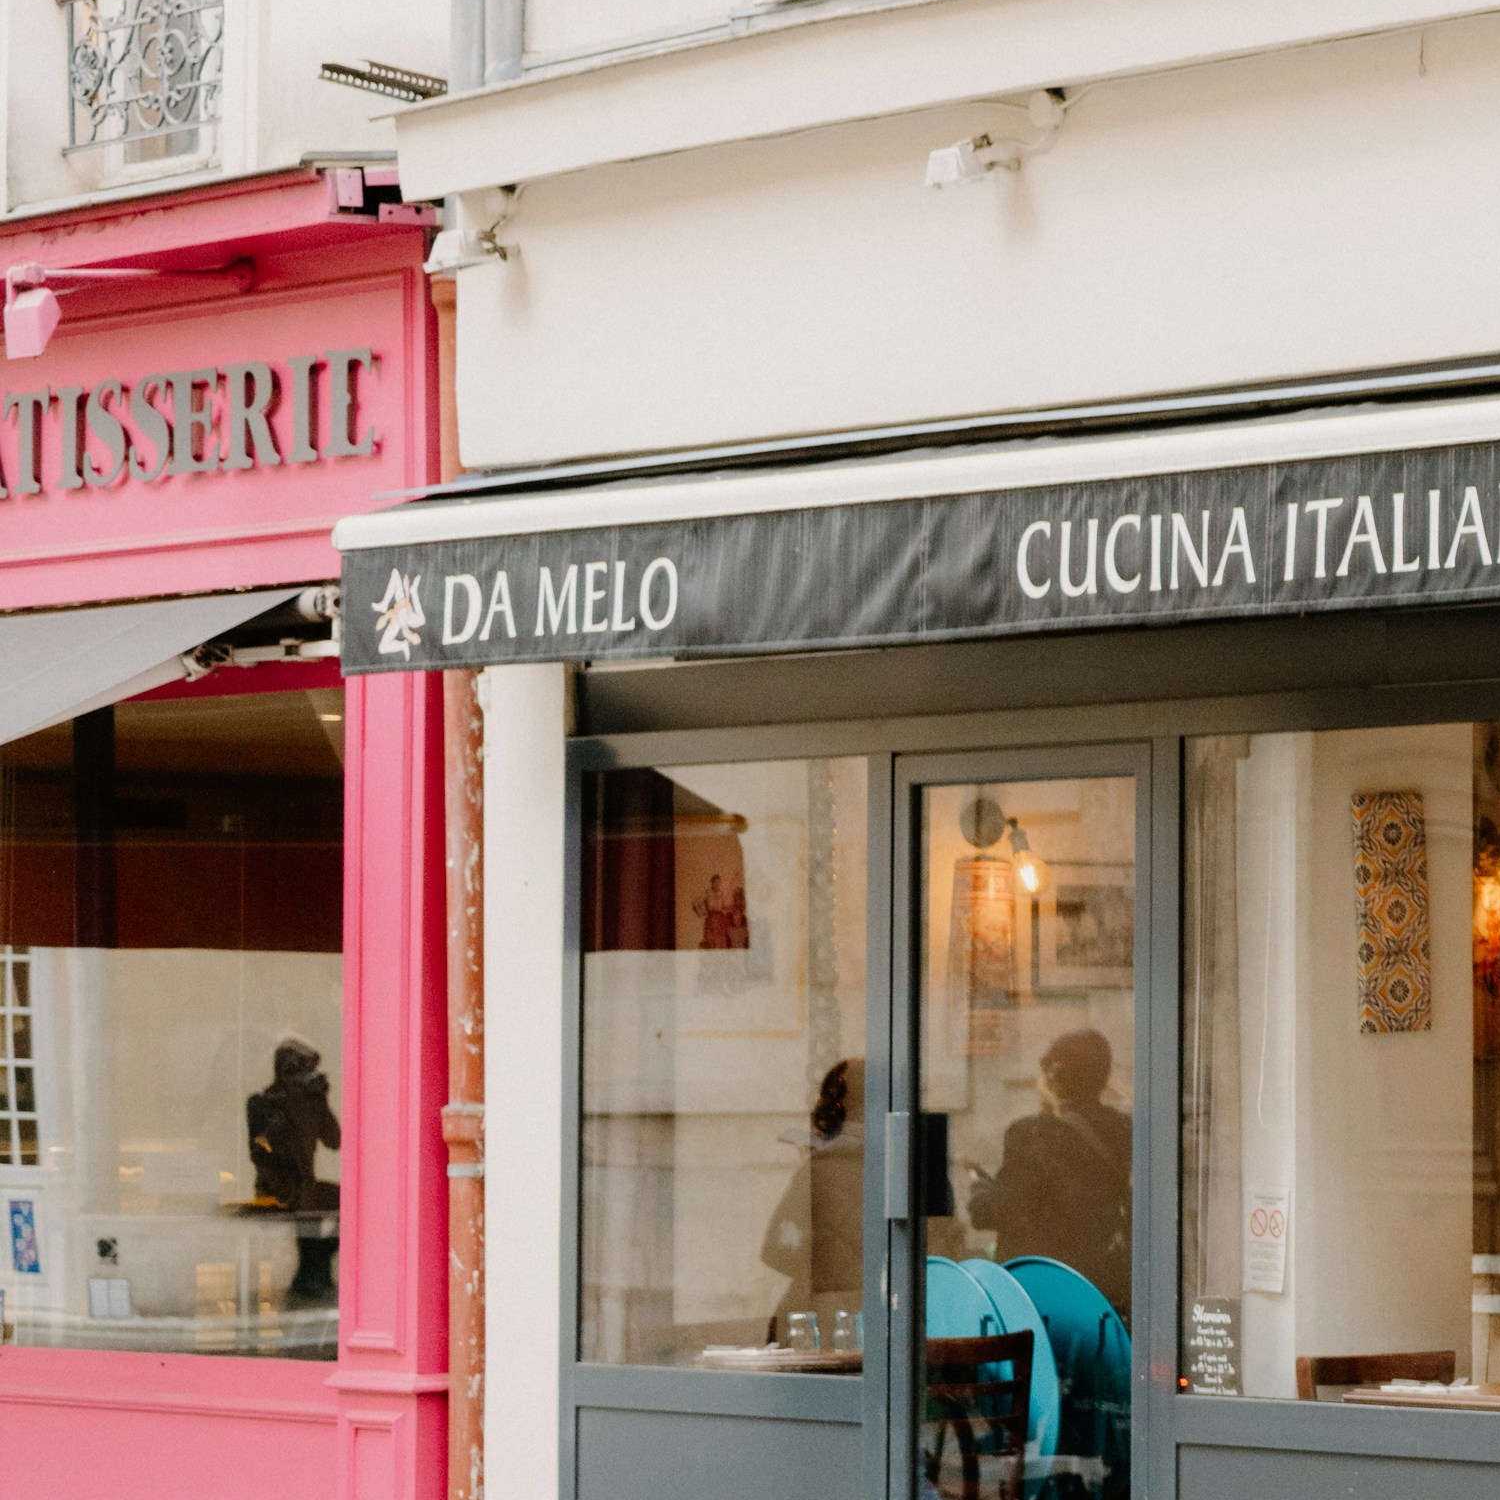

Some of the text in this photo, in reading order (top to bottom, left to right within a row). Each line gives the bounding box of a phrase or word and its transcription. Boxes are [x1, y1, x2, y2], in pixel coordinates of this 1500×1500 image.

[0, 348, 376, 498] TISSERIE
[1017, 507, 1257, 599] CUCINA
[442, 556, 678, 646] DA MELO
